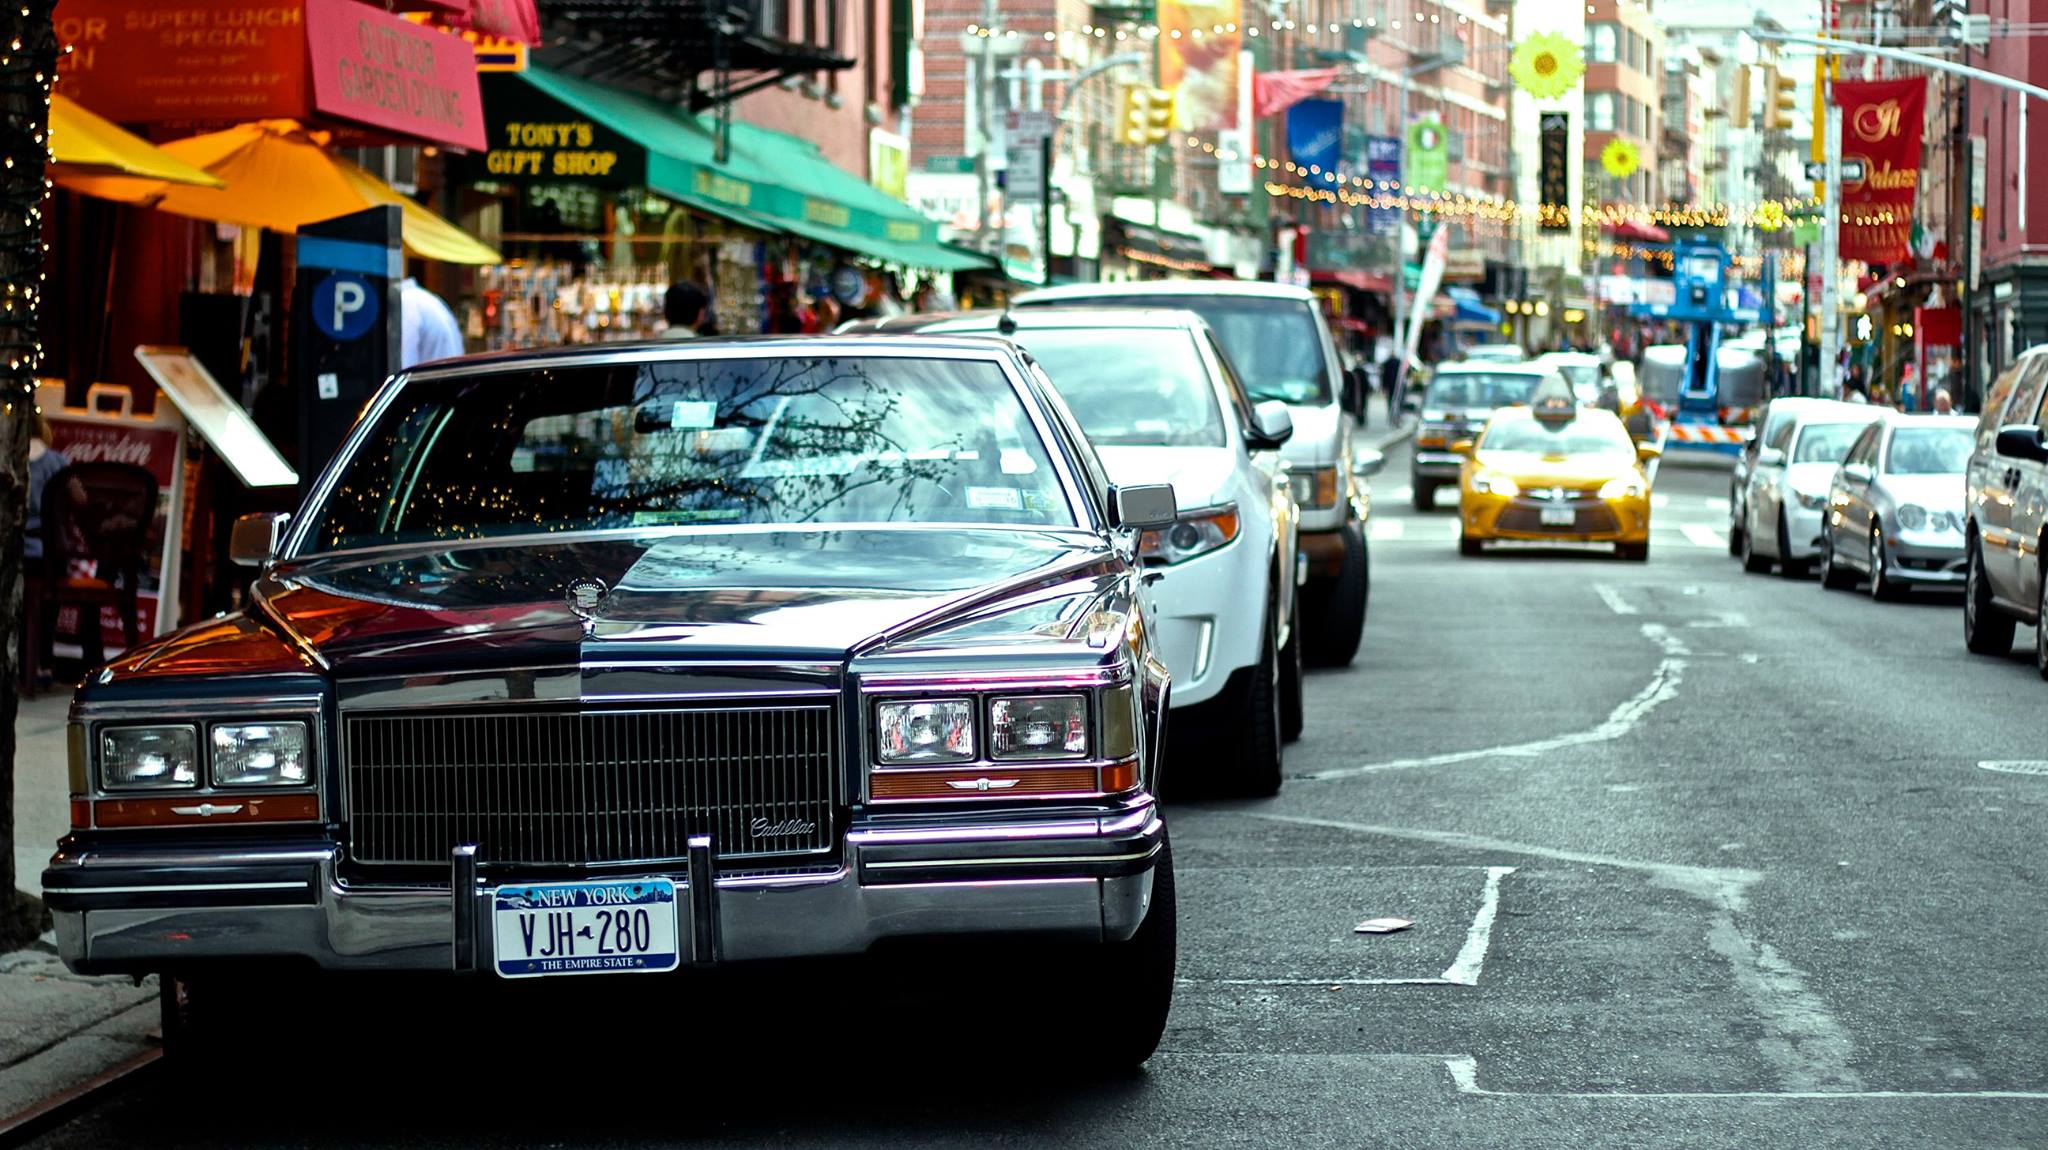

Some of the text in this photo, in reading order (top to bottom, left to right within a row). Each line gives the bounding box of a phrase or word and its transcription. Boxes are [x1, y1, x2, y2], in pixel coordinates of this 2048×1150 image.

[125, 7, 300, 30] SUPER LUNCH
[161, 28, 265, 48] SPECIAL
[358, 18, 437, 77] OUTDOOR
[338, 57, 409, 112] GARDEN
[506, 122, 593, 147] TONY'S
[487, 151, 617, 175] GIFT SHOP
[333, 281, 365, 331] P
[750, 817, 816, 838] Cadillac
[537, 886, 631, 907] NEW YORK
[541, 957, 634, 970] THE EMPIRE STATE
